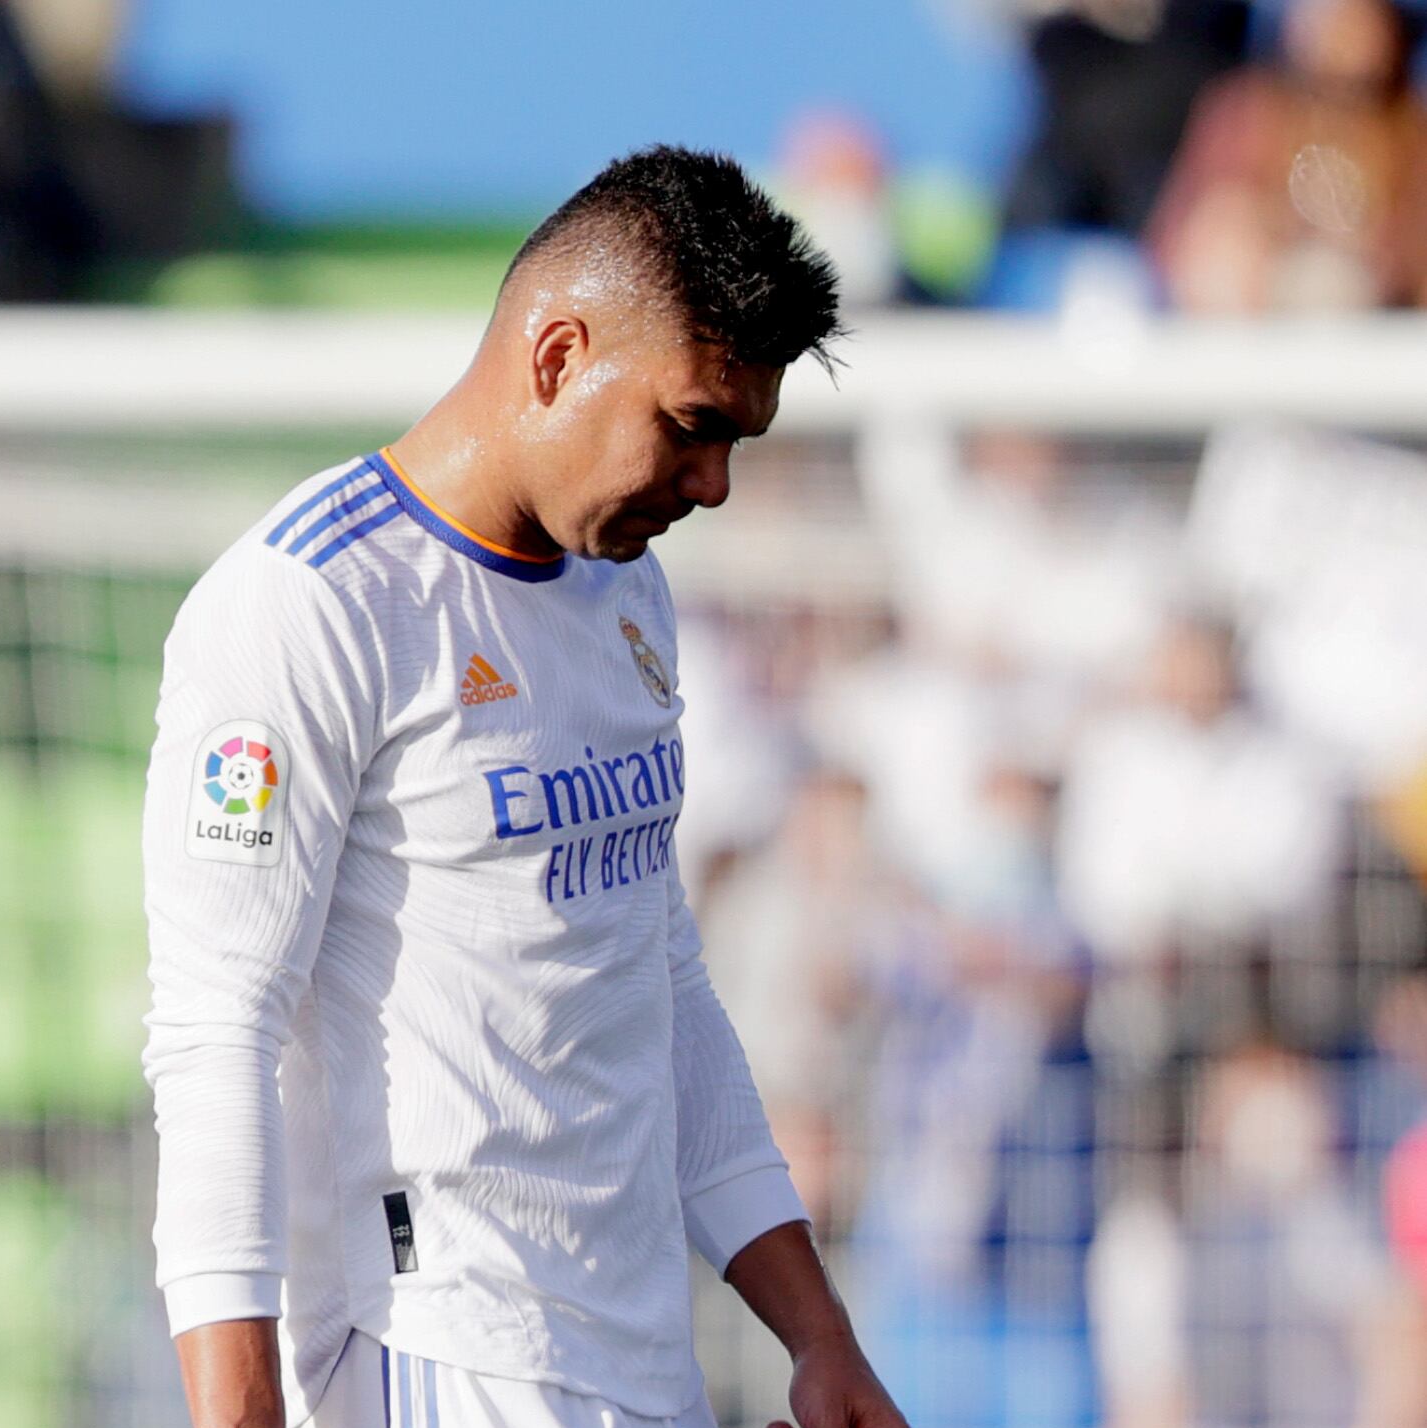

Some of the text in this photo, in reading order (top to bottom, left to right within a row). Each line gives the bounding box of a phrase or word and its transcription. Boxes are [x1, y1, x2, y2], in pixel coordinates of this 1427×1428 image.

[460, 682, 519, 706] adidas
[196, 820, 273, 849] LaLiga
[547, 836, 594, 903] FLY
